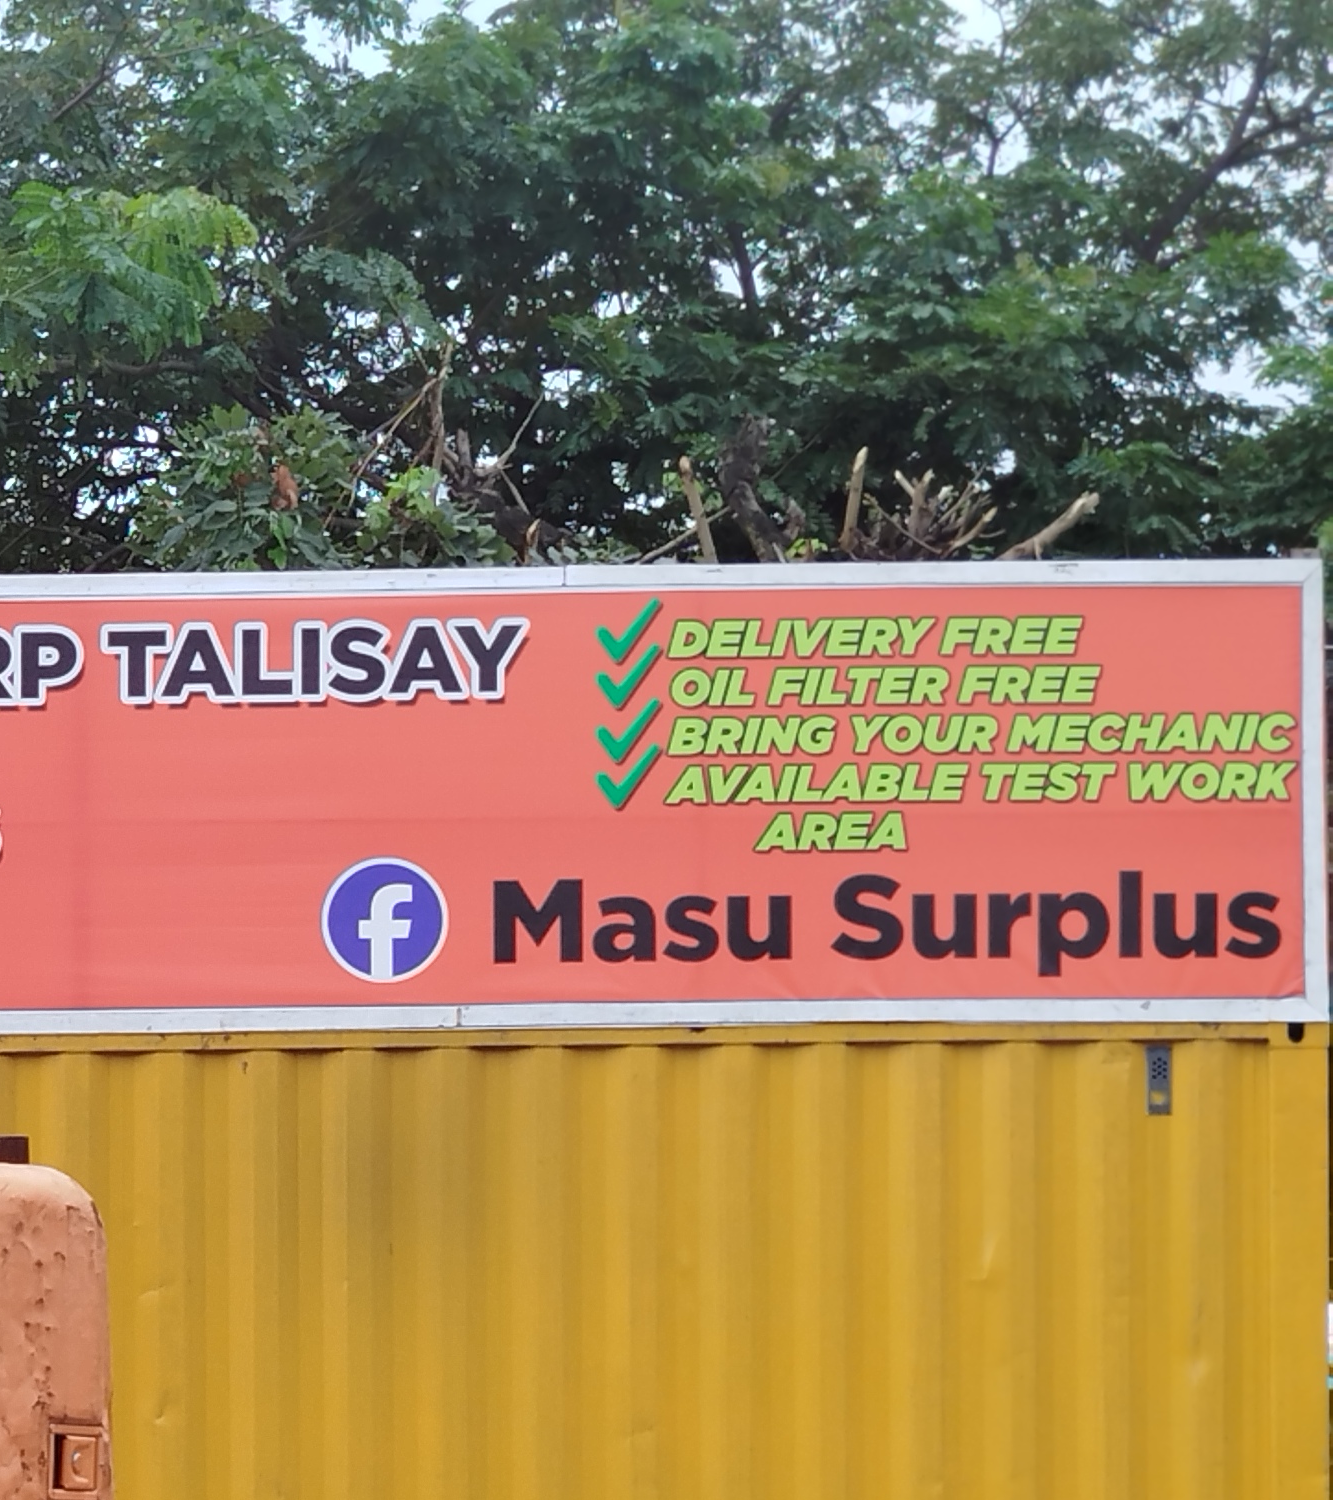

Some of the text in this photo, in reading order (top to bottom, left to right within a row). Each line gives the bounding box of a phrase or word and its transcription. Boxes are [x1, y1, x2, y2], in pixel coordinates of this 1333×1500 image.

[668, 616, 1083, 658] DELIVERY FREE
[100, 617, 529, 705] TALISAY
[670, 665, 1101, 707] OIL FILTER FREE
[668, 712, 1297, 757] BRING YOUR MECHANIC
[664, 761, 1297, 805] AVAILABLE TEST WORK
[755, 812, 908, 852] AREA
[493, 871, 1281, 977] Masu Surplus
